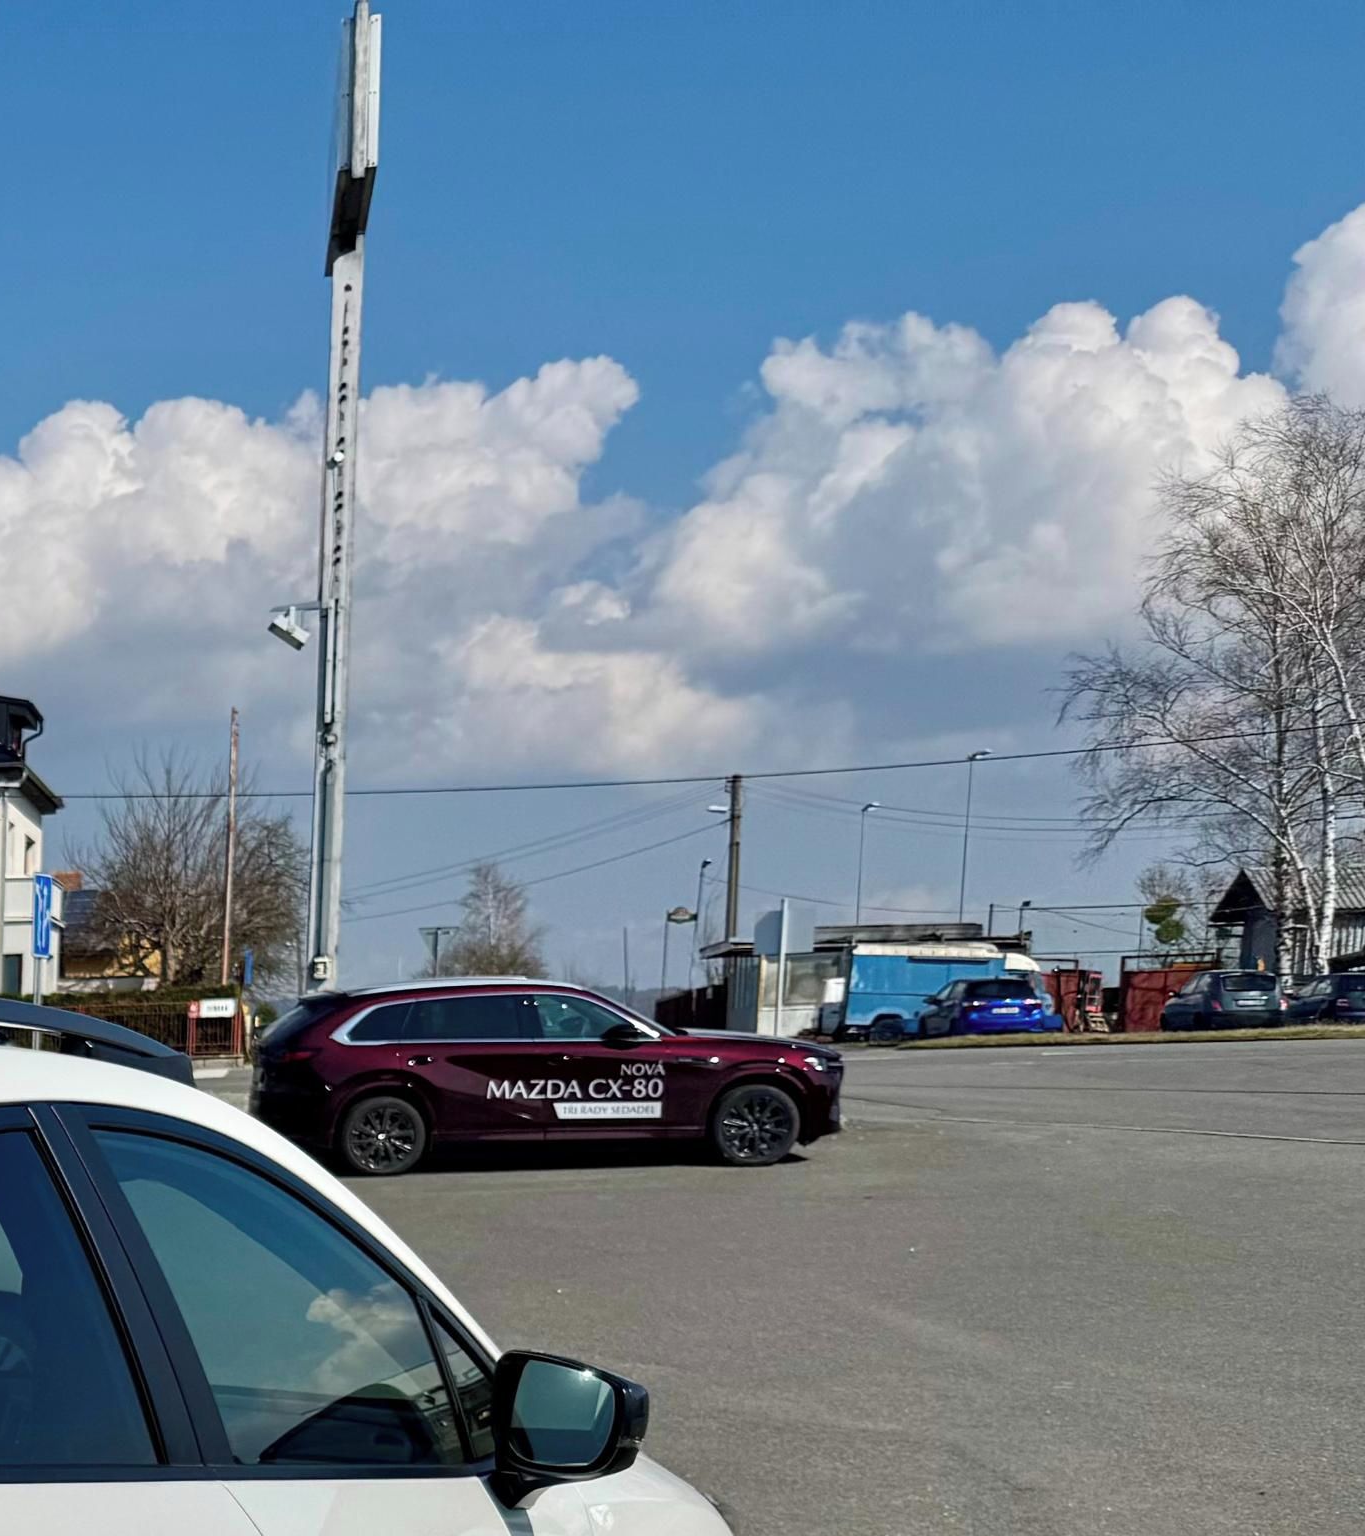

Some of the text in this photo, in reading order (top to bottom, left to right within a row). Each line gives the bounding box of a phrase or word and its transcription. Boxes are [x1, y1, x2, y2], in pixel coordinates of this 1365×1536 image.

[620, 1060, 665, 1076] NOVÁ
[486, 1078, 664, 1099] MAZDA CX-80
